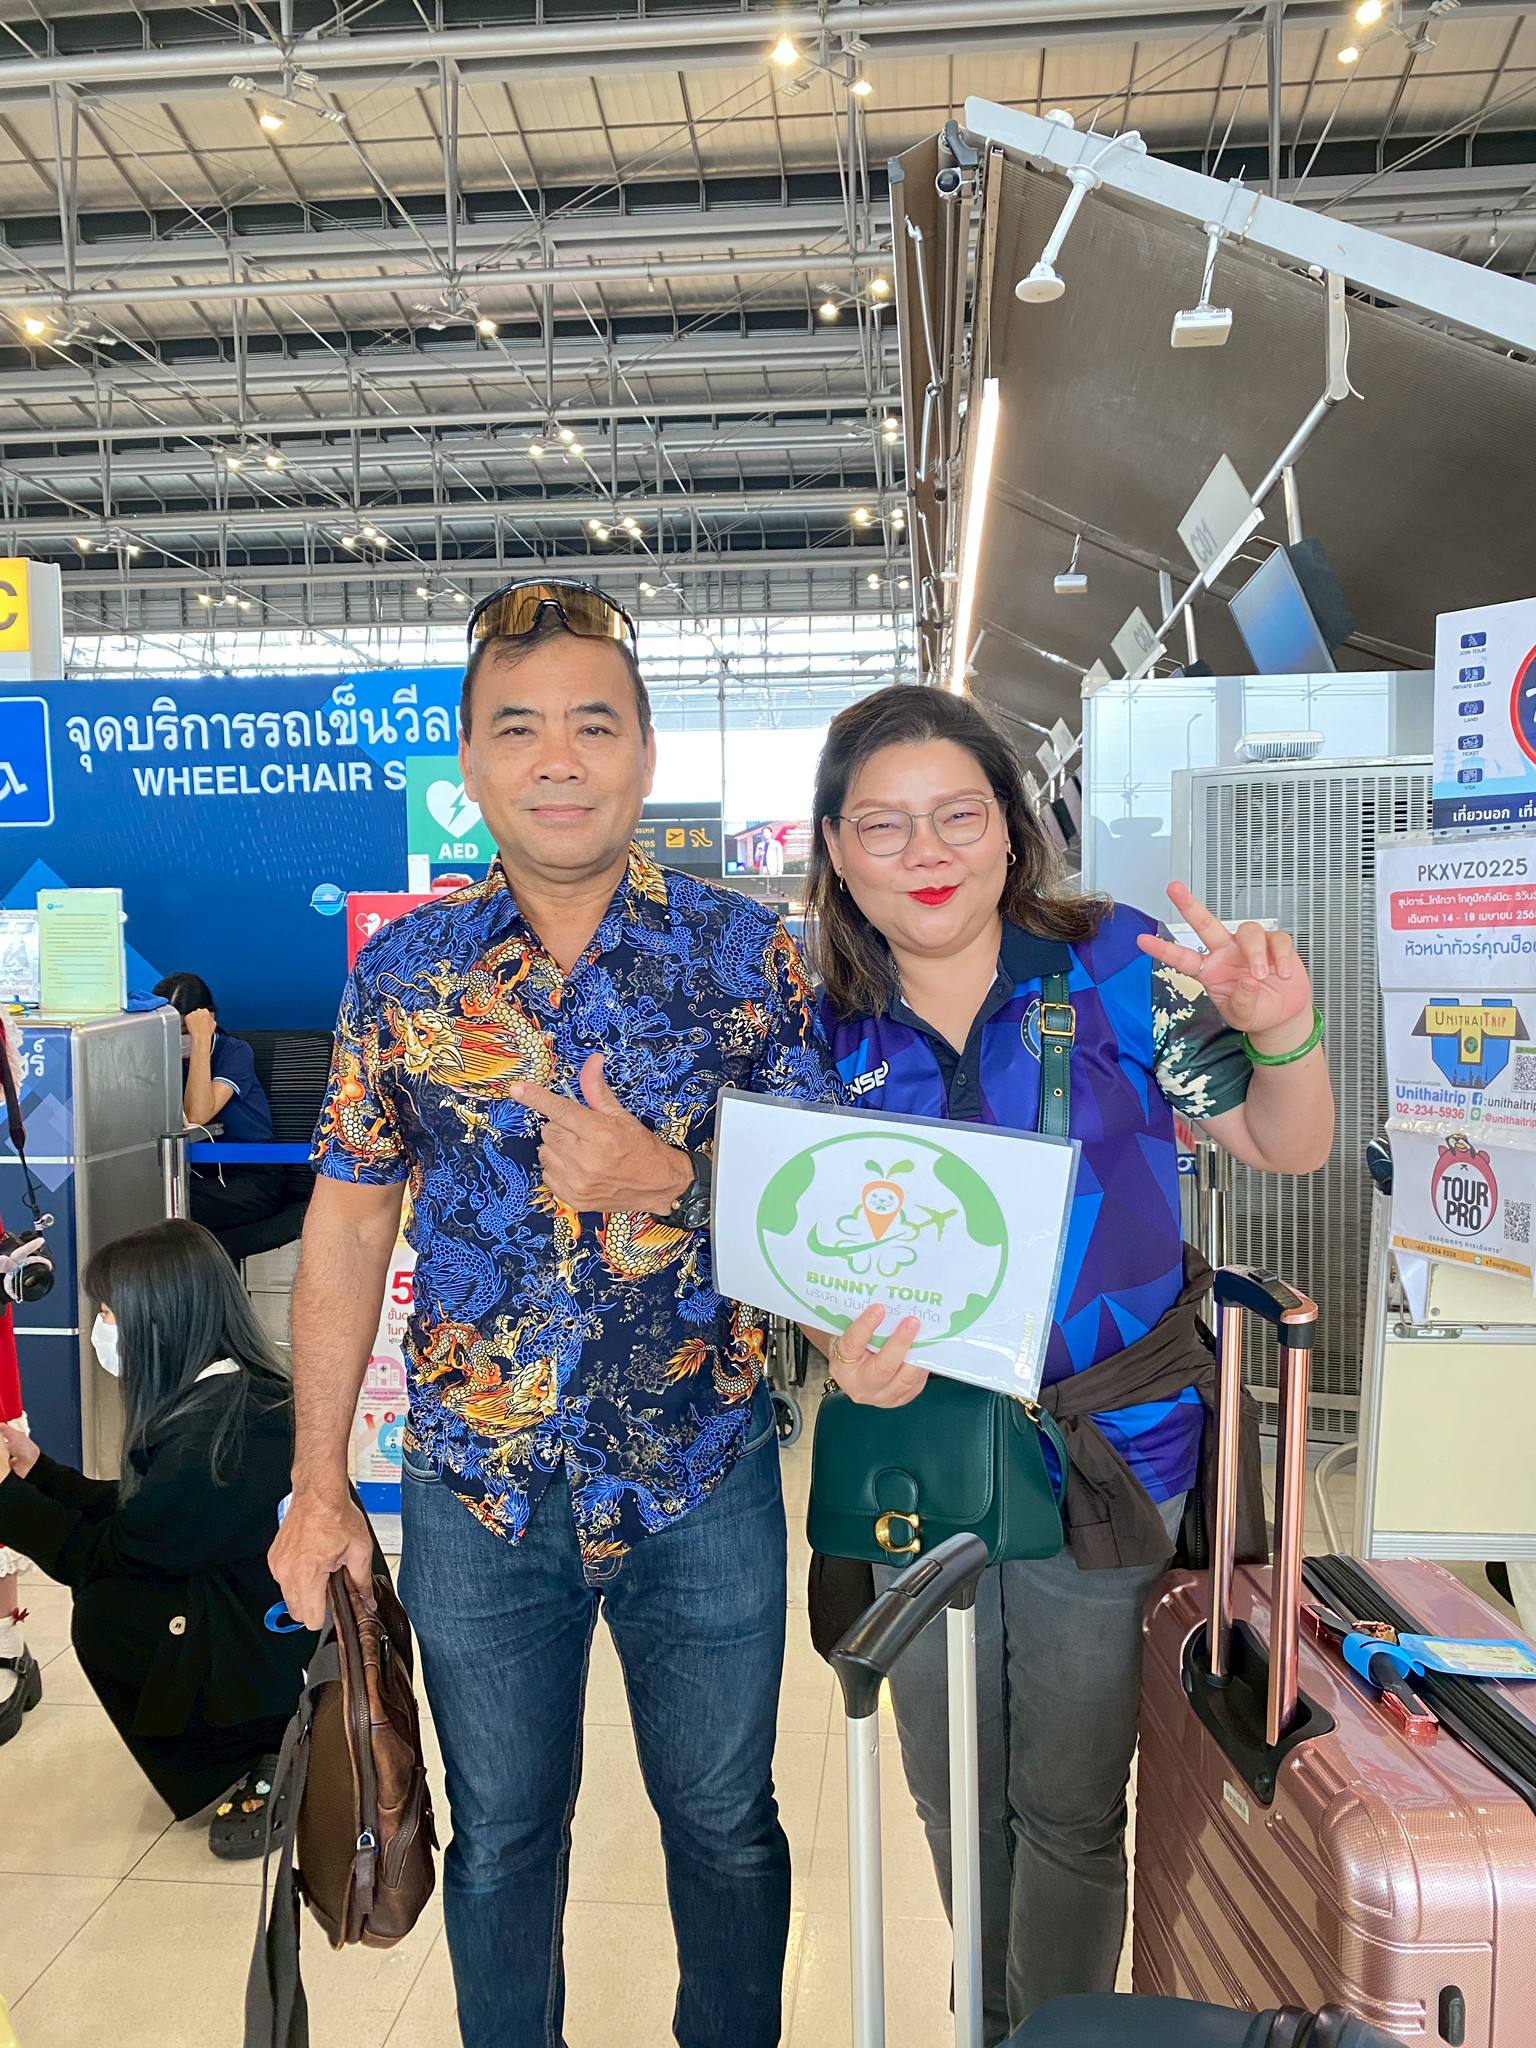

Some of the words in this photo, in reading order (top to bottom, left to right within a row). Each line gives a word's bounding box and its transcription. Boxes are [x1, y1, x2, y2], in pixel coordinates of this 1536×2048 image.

[1190, 518, 1218, 564] C01
[133, 763, 373, 796] WHEELCHAIR
[1453, 803, 1511, 822] เที่ยวนอก
[438, 843, 479, 860] AED
[1407, 913, 1439, 924] เดินทาง
[1442, 913, 1454, 923] 14
[1464, 912, 1475, 922] 18
[1478, 910, 1513, 921] เมษายน
[1516, 909, 1536, 920] 256
[1395, 1085, 1467, 1107] Unithaitrip
[1396, 1102, 1465, 1120] 02-234-5936
[1441, 1175, 1489, 1208] TOUR
[1445, 1201, 1482, 1231] PRO
[391, 1271, 414, 1305] 5
[806, 1270, 879, 1297] BUNNY
[886, 1284, 944, 1307] TOUR
[806, 1286, 838, 1304] บริษัท
[386, 1411, 394, 1422] 4
